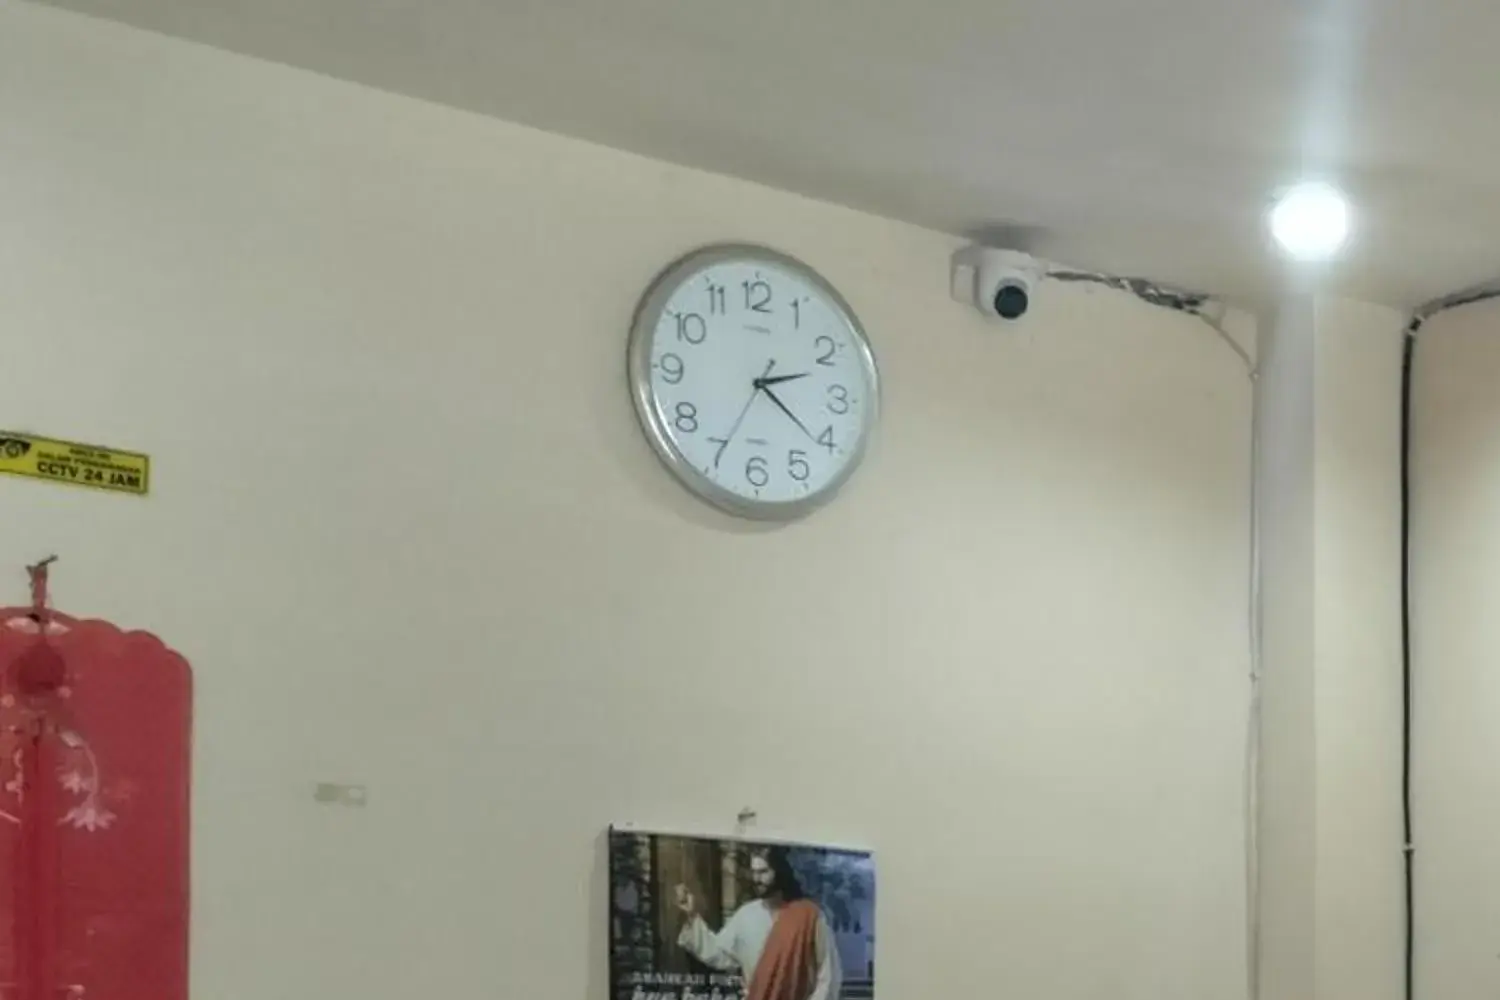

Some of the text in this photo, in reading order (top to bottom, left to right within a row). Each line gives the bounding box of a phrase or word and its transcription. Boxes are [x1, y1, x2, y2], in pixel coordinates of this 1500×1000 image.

[707, 285, 726, 316] 11
[741, 280, 773, 313] 12
[674, 312, 707, 345] 10
[790, 298, 800, 330] 1
[814, 335, 836, 366] 2
[660, 353, 684, 385] 9
[827, 384, 849, 415] 3
[675, 402, 698, 433] 8
[706, 436, 729, 469] 7
[817, 424, 837, 455] 4
[37, 461, 79, 478] CCTV
[84, 468, 103, 482] 24
[109, 473, 141, 488] JAM
[745, 457, 769, 487] 6
[787, 449, 810, 481] 5
